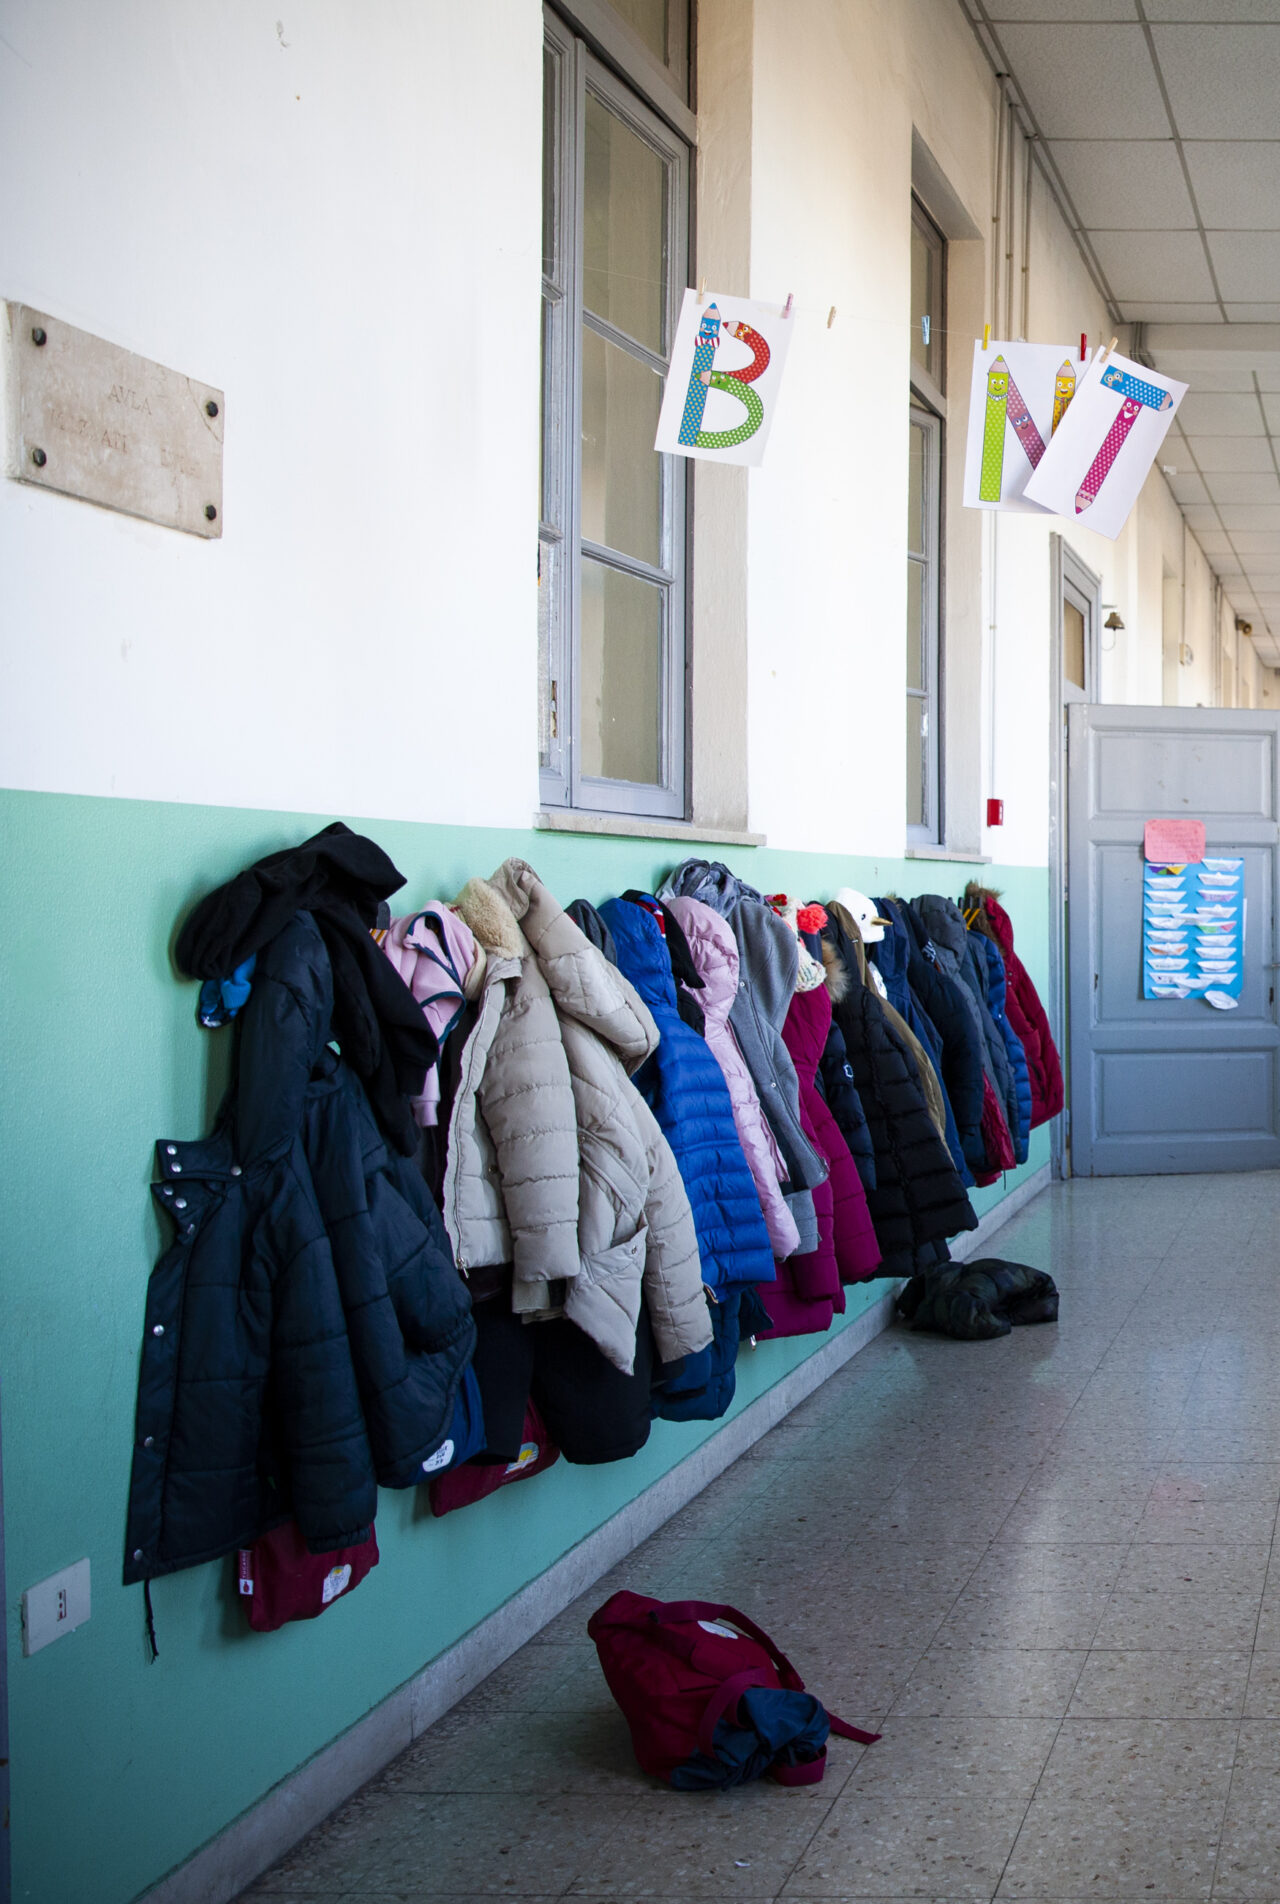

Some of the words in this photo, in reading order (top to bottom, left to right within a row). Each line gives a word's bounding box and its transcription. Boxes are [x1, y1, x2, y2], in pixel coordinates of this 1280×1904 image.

[108, 385, 152, 416] AVLA
[677, 302, 771, 449] B
[979, 354, 1076, 502] N
[1075, 365, 1174, 515] T
